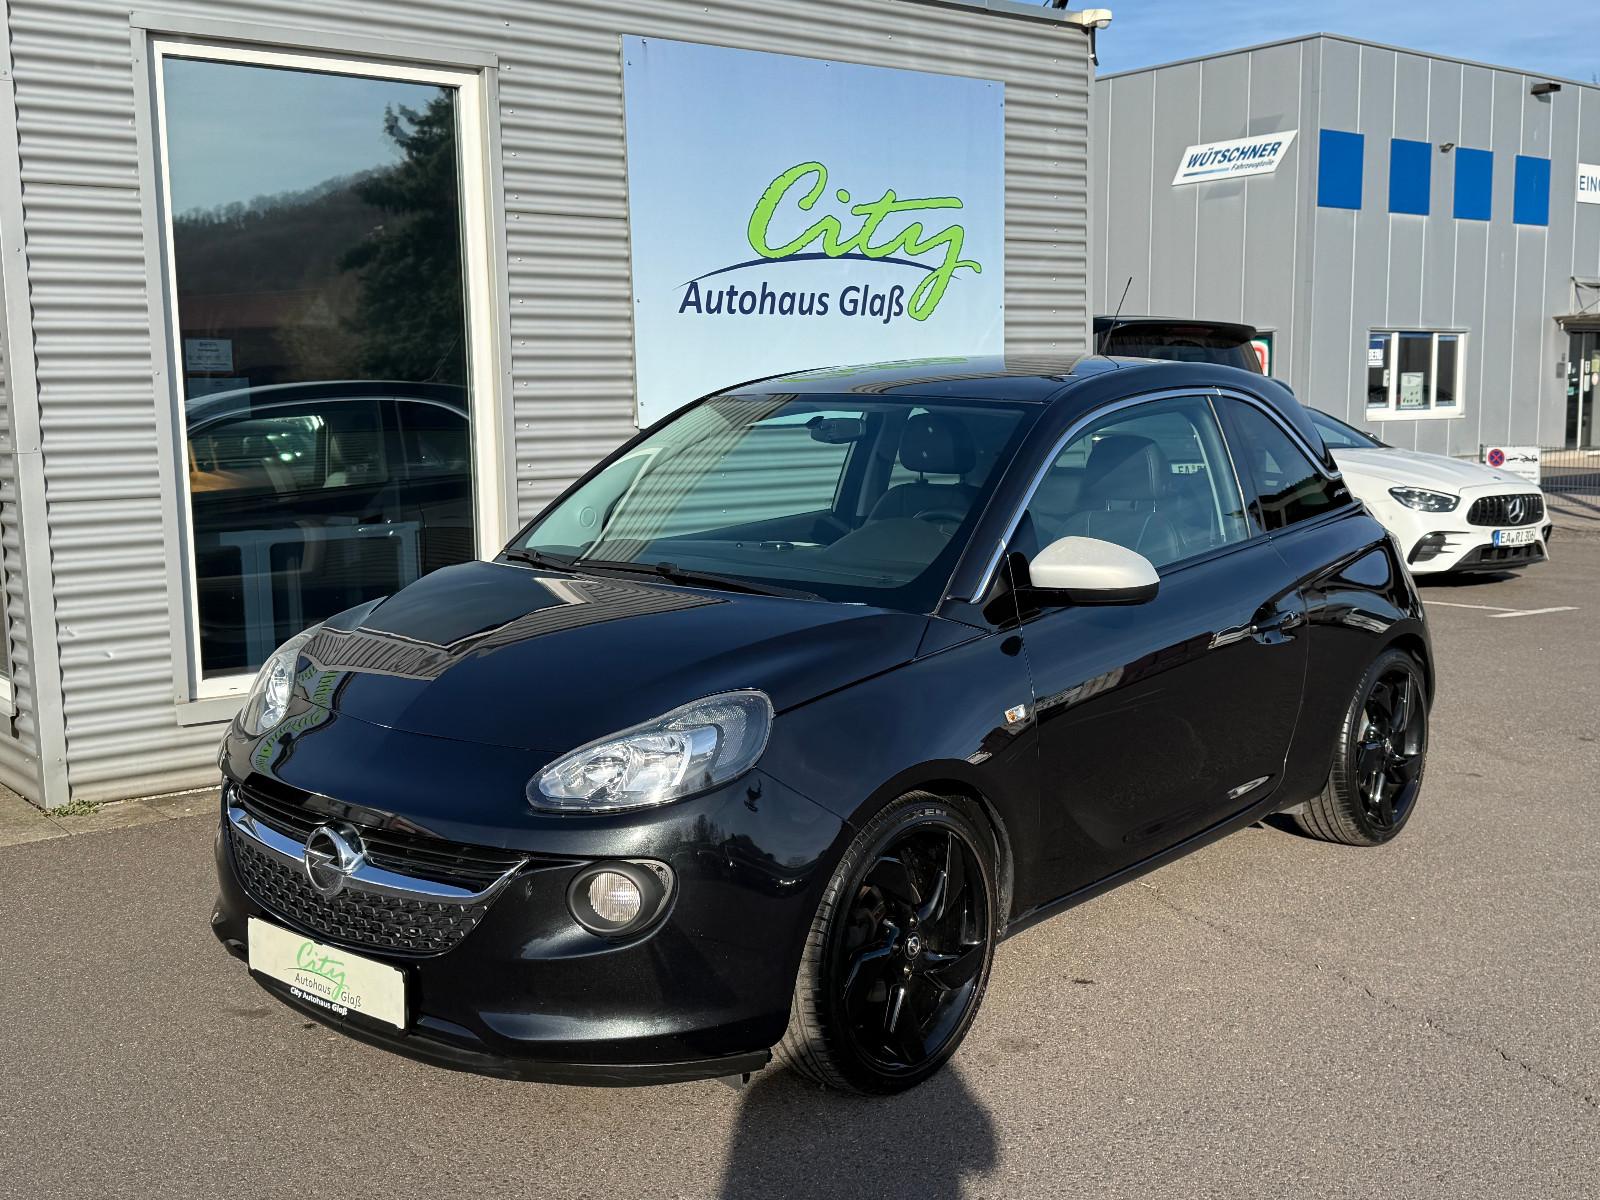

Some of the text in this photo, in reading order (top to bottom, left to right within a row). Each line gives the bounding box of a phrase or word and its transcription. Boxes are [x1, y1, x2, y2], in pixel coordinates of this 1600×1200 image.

[1186, 141, 1282, 168] WÜTSCHNER
[748, 161, 983, 322] City
[678, 281, 905, 325] Autohaus Glaß
[1500, 532, 1511, 544] EA
[297, 942, 349, 1001] City
[290, 987, 348, 1016] City Autohaus Glaß
[295, 973, 362, 1009] Autohaus Glaß
